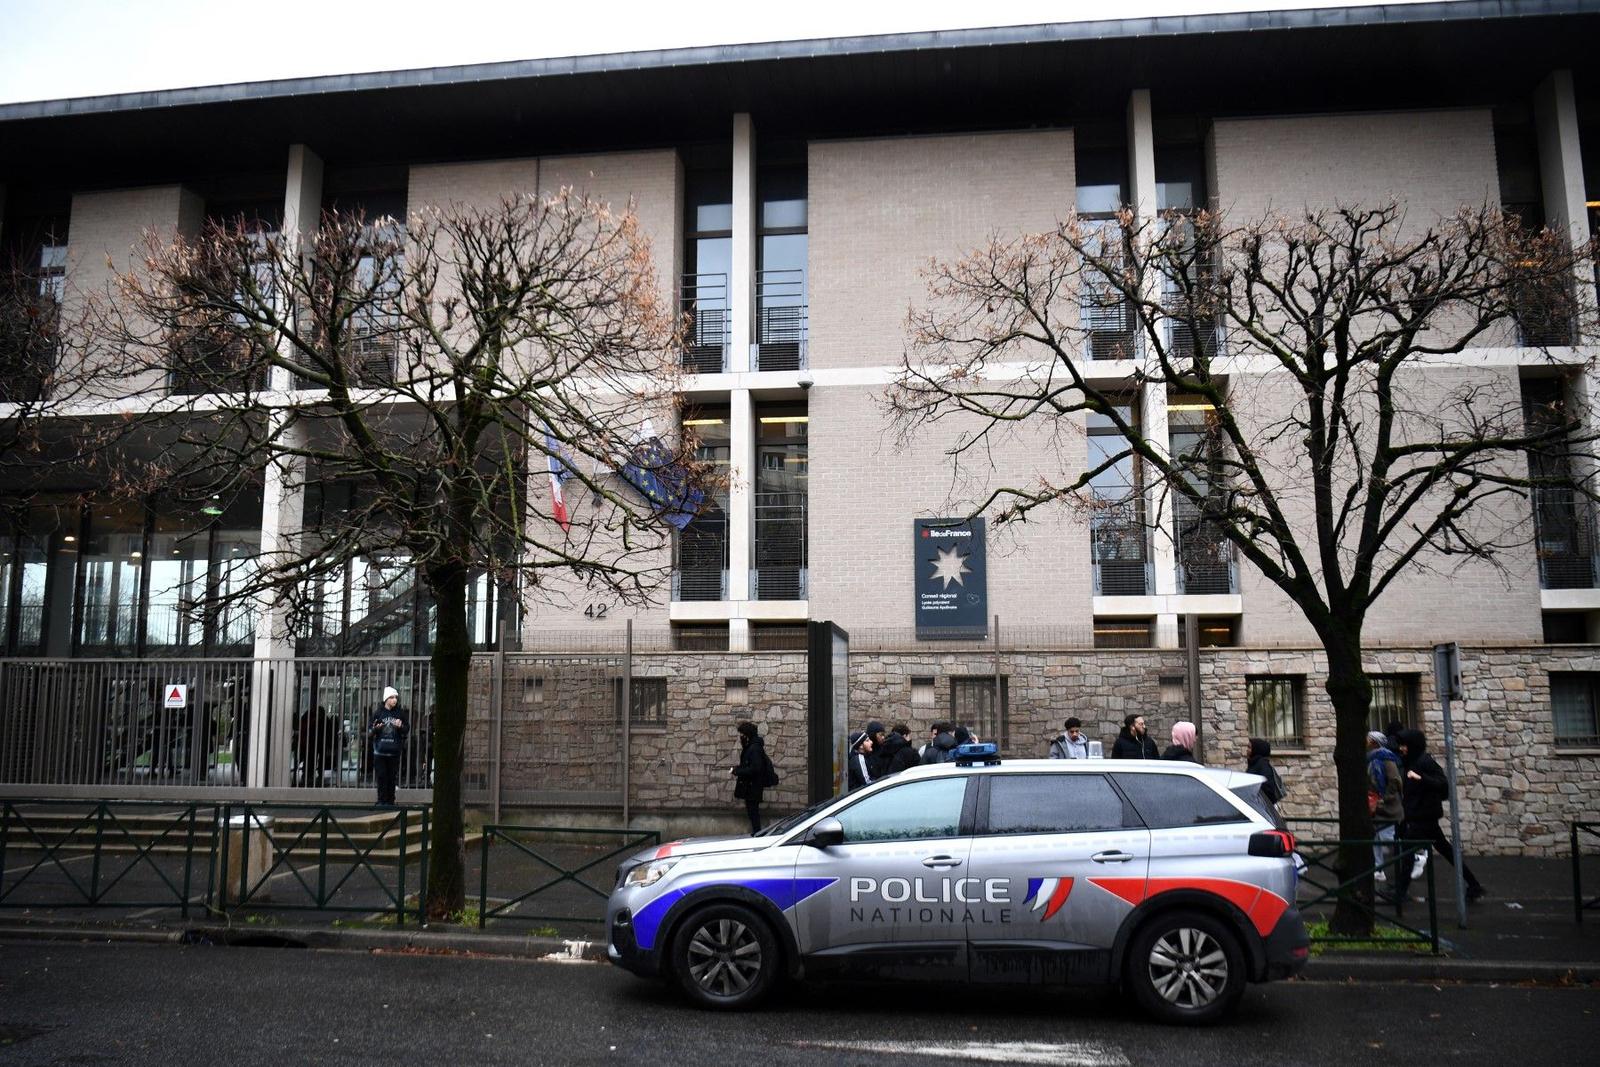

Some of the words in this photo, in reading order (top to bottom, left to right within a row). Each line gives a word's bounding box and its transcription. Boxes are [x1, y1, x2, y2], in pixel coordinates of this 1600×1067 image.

[584, 603, 607, 618] 42
[850, 876, 1011, 903] POLICE
[850, 907, 1012, 923] NATIONALE
